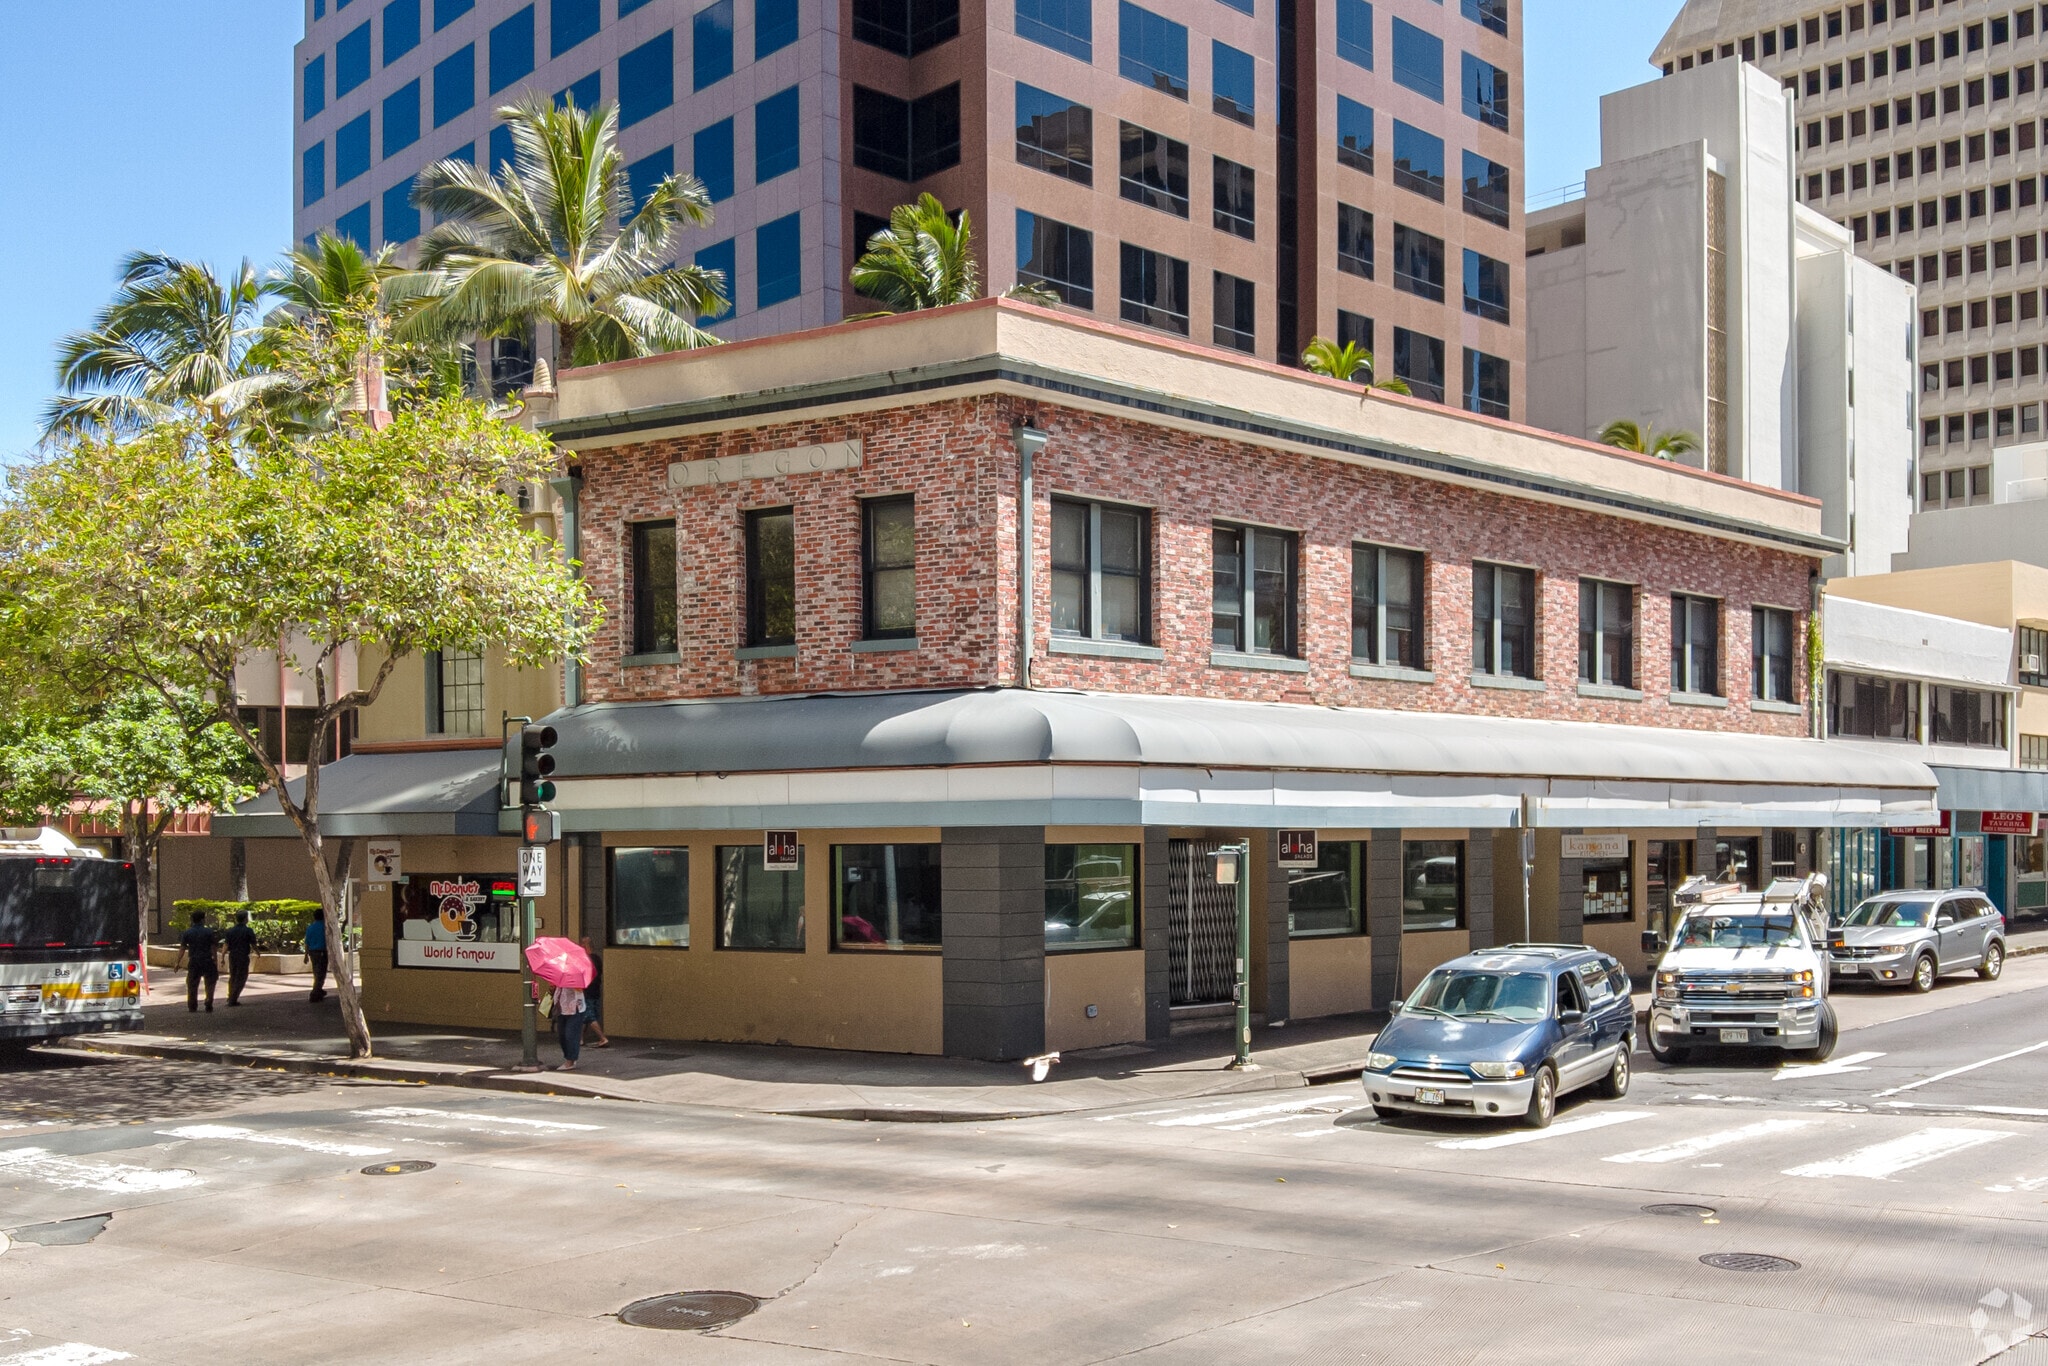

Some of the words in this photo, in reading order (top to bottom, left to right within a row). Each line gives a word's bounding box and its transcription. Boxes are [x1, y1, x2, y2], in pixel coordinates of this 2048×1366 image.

[670, 440, 862, 485] OREGON
[1992, 812, 2023, 821] LEO'S
[522, 852, 542, 863] ONE
[522, 865, 543, 876] WAY
[492, 881, 515, 891] OPEN
[423, 945, 453, 959] World
[456, 946, 496, 963] Famous
